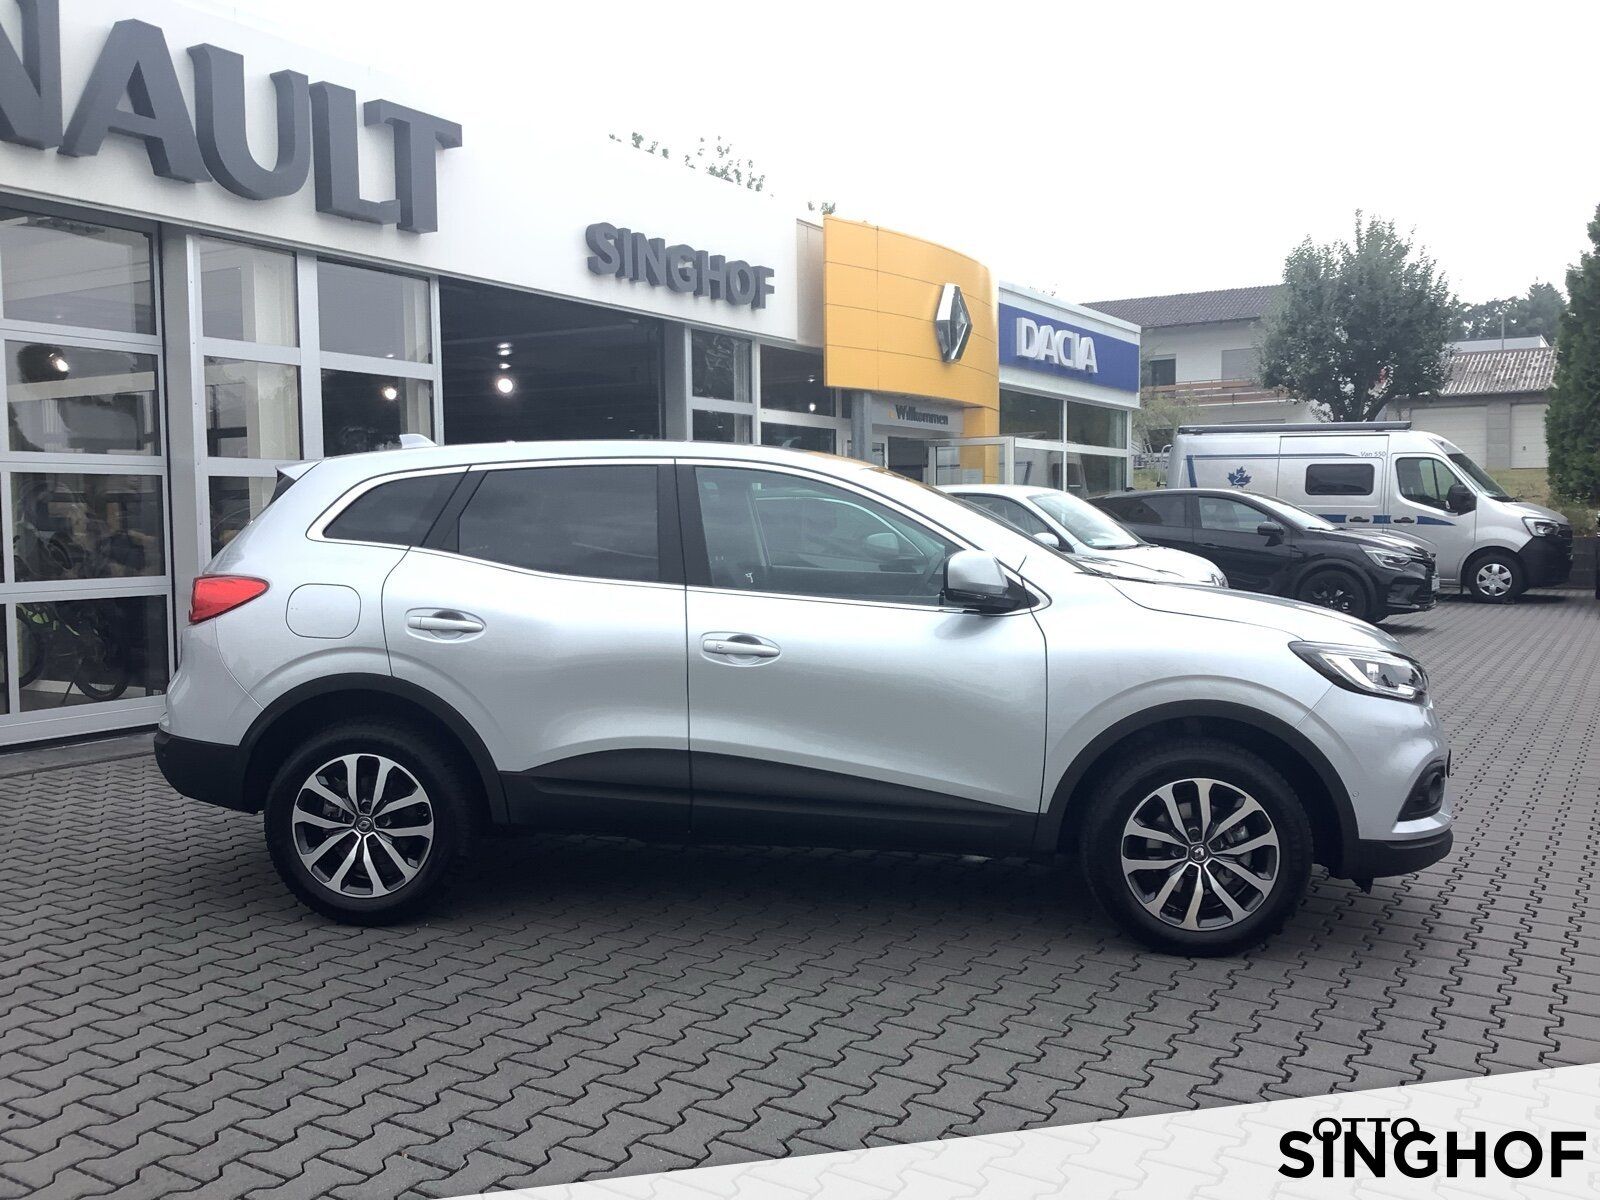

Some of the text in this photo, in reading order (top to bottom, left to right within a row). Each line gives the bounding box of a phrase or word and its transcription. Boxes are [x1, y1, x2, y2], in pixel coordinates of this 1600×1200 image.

[585, 222, 775, 310] SINGHOF
[1016, 317, 1098, 374] DACIA
[896, 404, 949, 425] Willkommen
